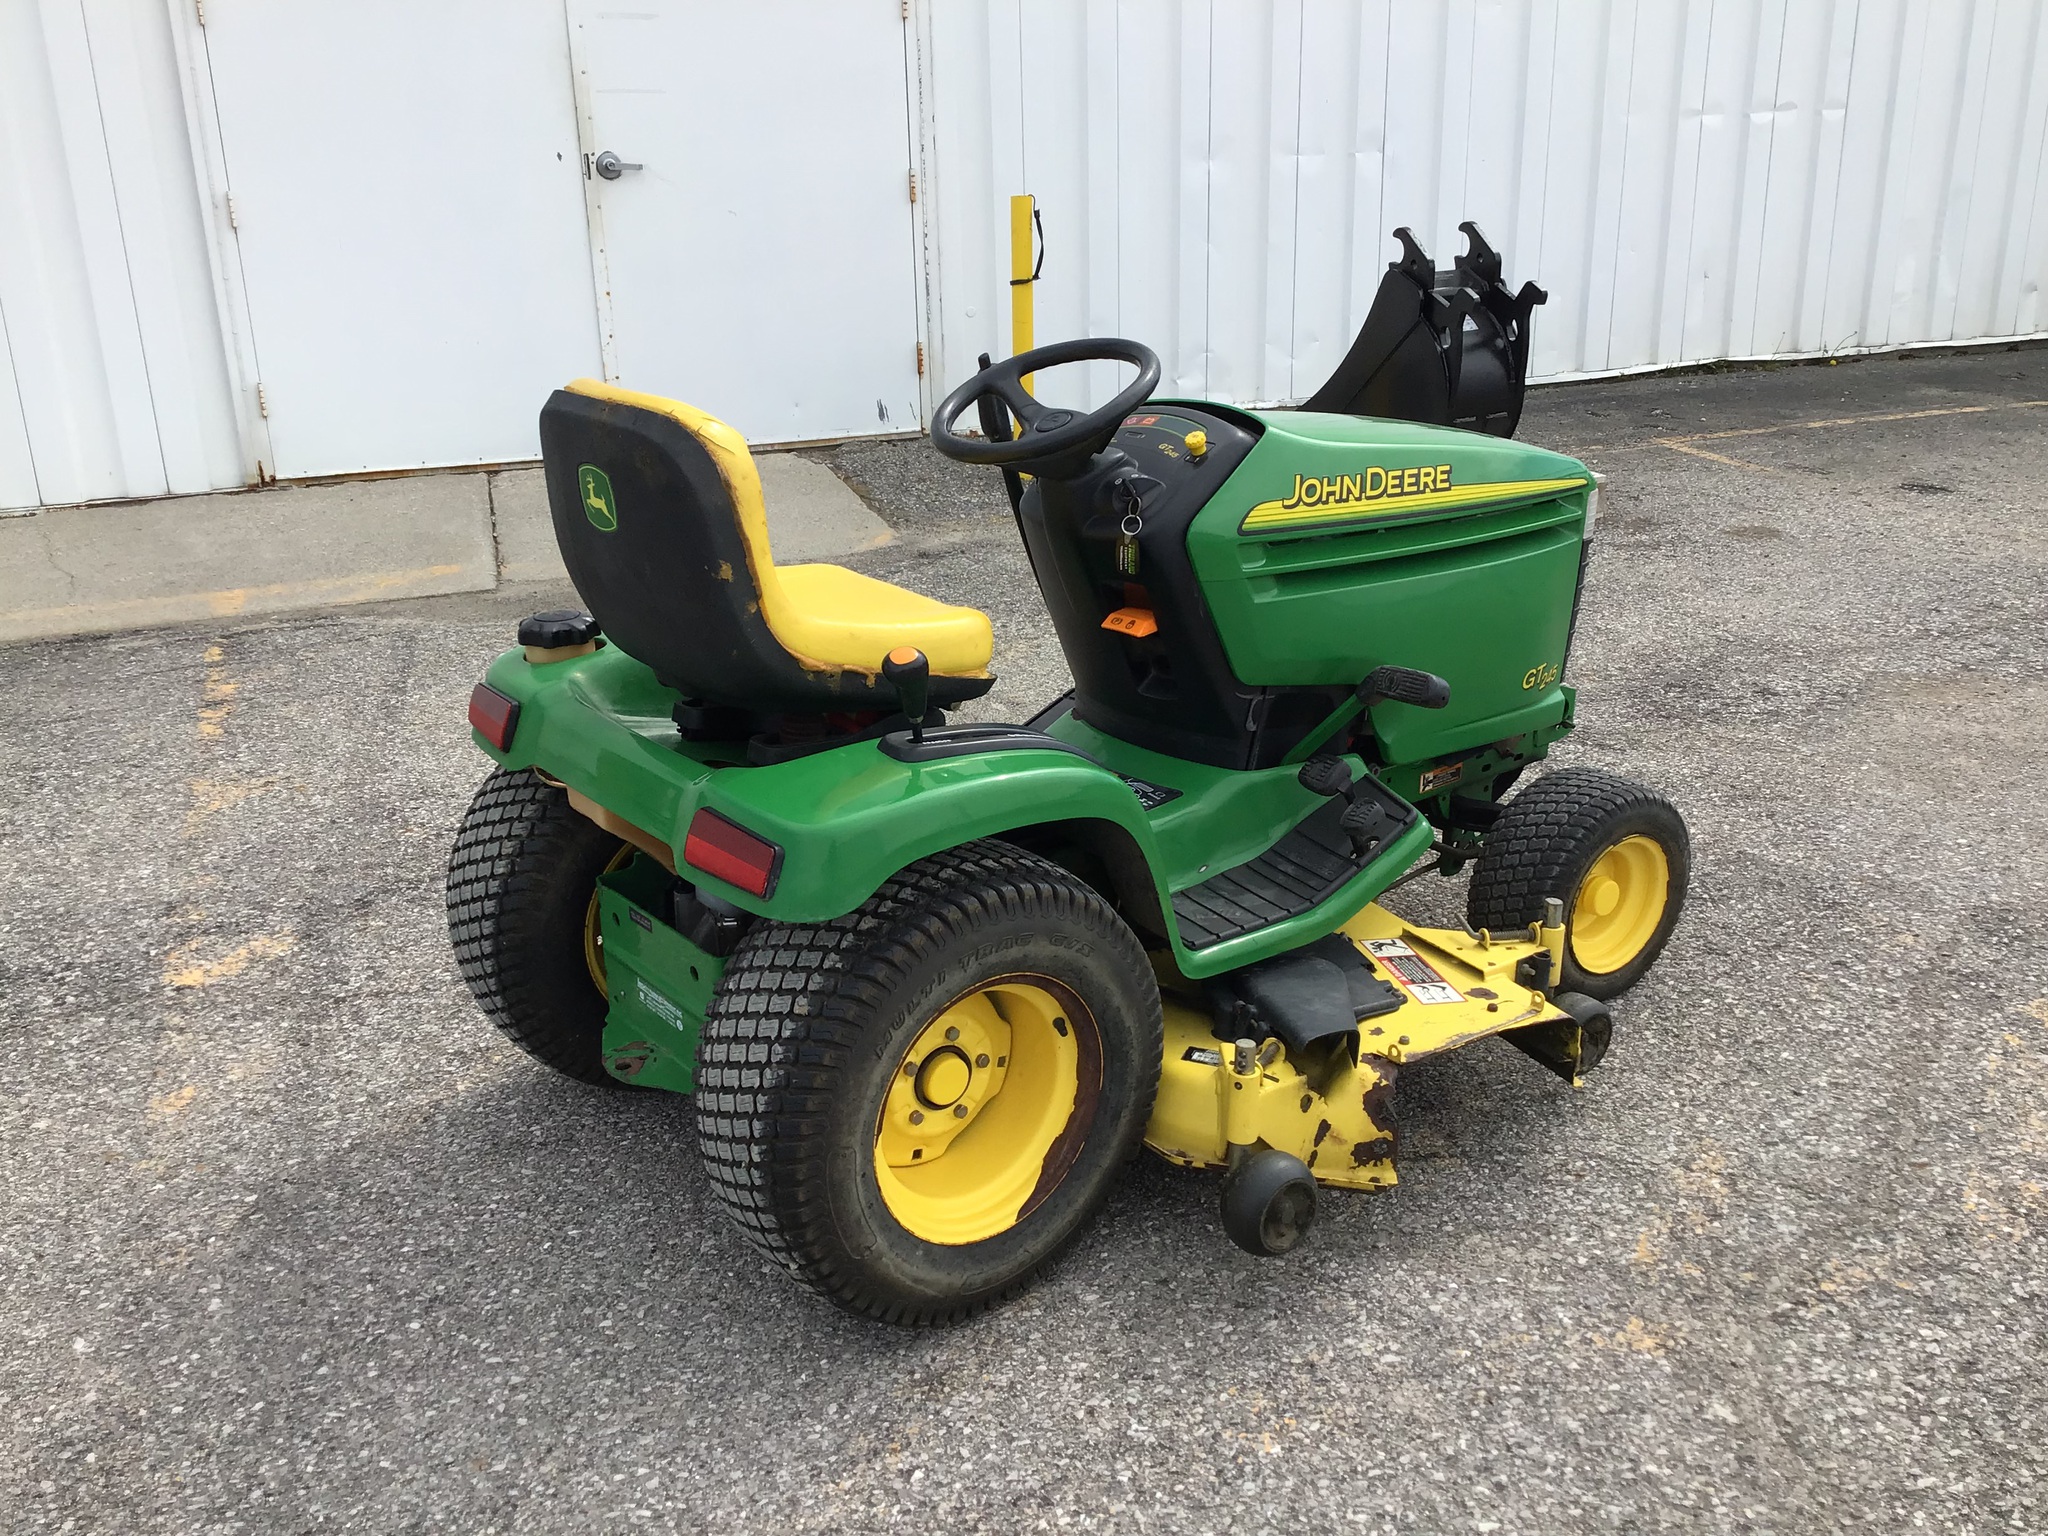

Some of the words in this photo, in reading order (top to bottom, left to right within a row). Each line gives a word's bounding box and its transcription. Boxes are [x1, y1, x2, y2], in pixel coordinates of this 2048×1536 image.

[1282, 473, 1363, 509] JOHN
[1365, 464, 1452, 500] DEERE
[1522, 662, 1559, 690] GT245
[957, 931, 1036, 973] TRAC
